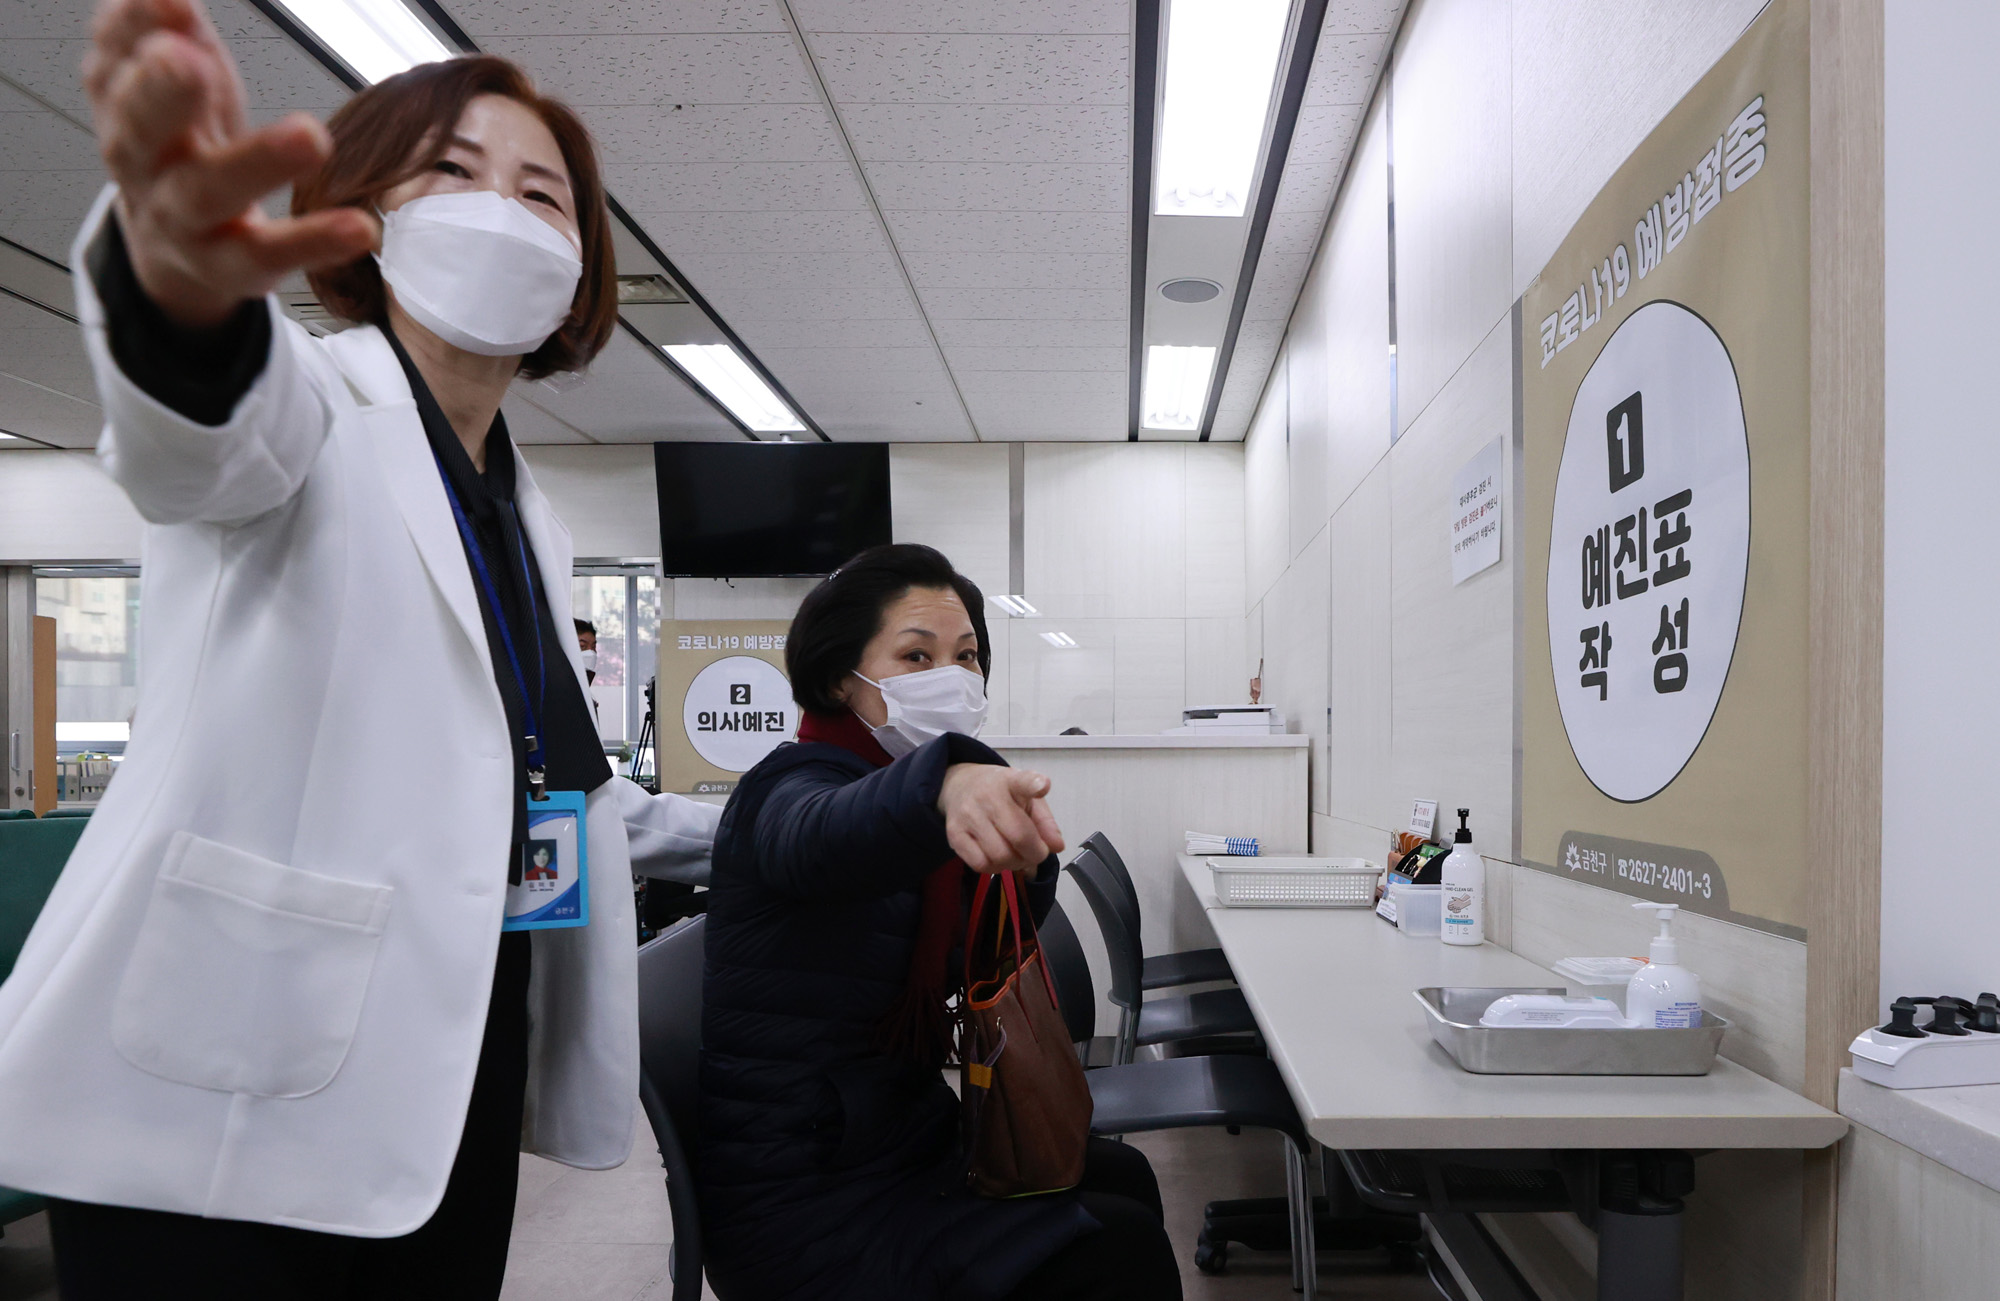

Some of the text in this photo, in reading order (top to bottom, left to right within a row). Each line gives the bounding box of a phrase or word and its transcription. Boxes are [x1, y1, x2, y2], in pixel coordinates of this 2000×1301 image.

[1540, 95, 1766, 370] 코로나19 예방접종
[1581, 487, 1694, 610] 예진표
[677, 634, 788, 650] 코로나19 예방접
[697, 711, 785, 732] 의사예진
[711, 784, 729, 792] 금천구
[1582, 848, 1607, 875] 금천구
